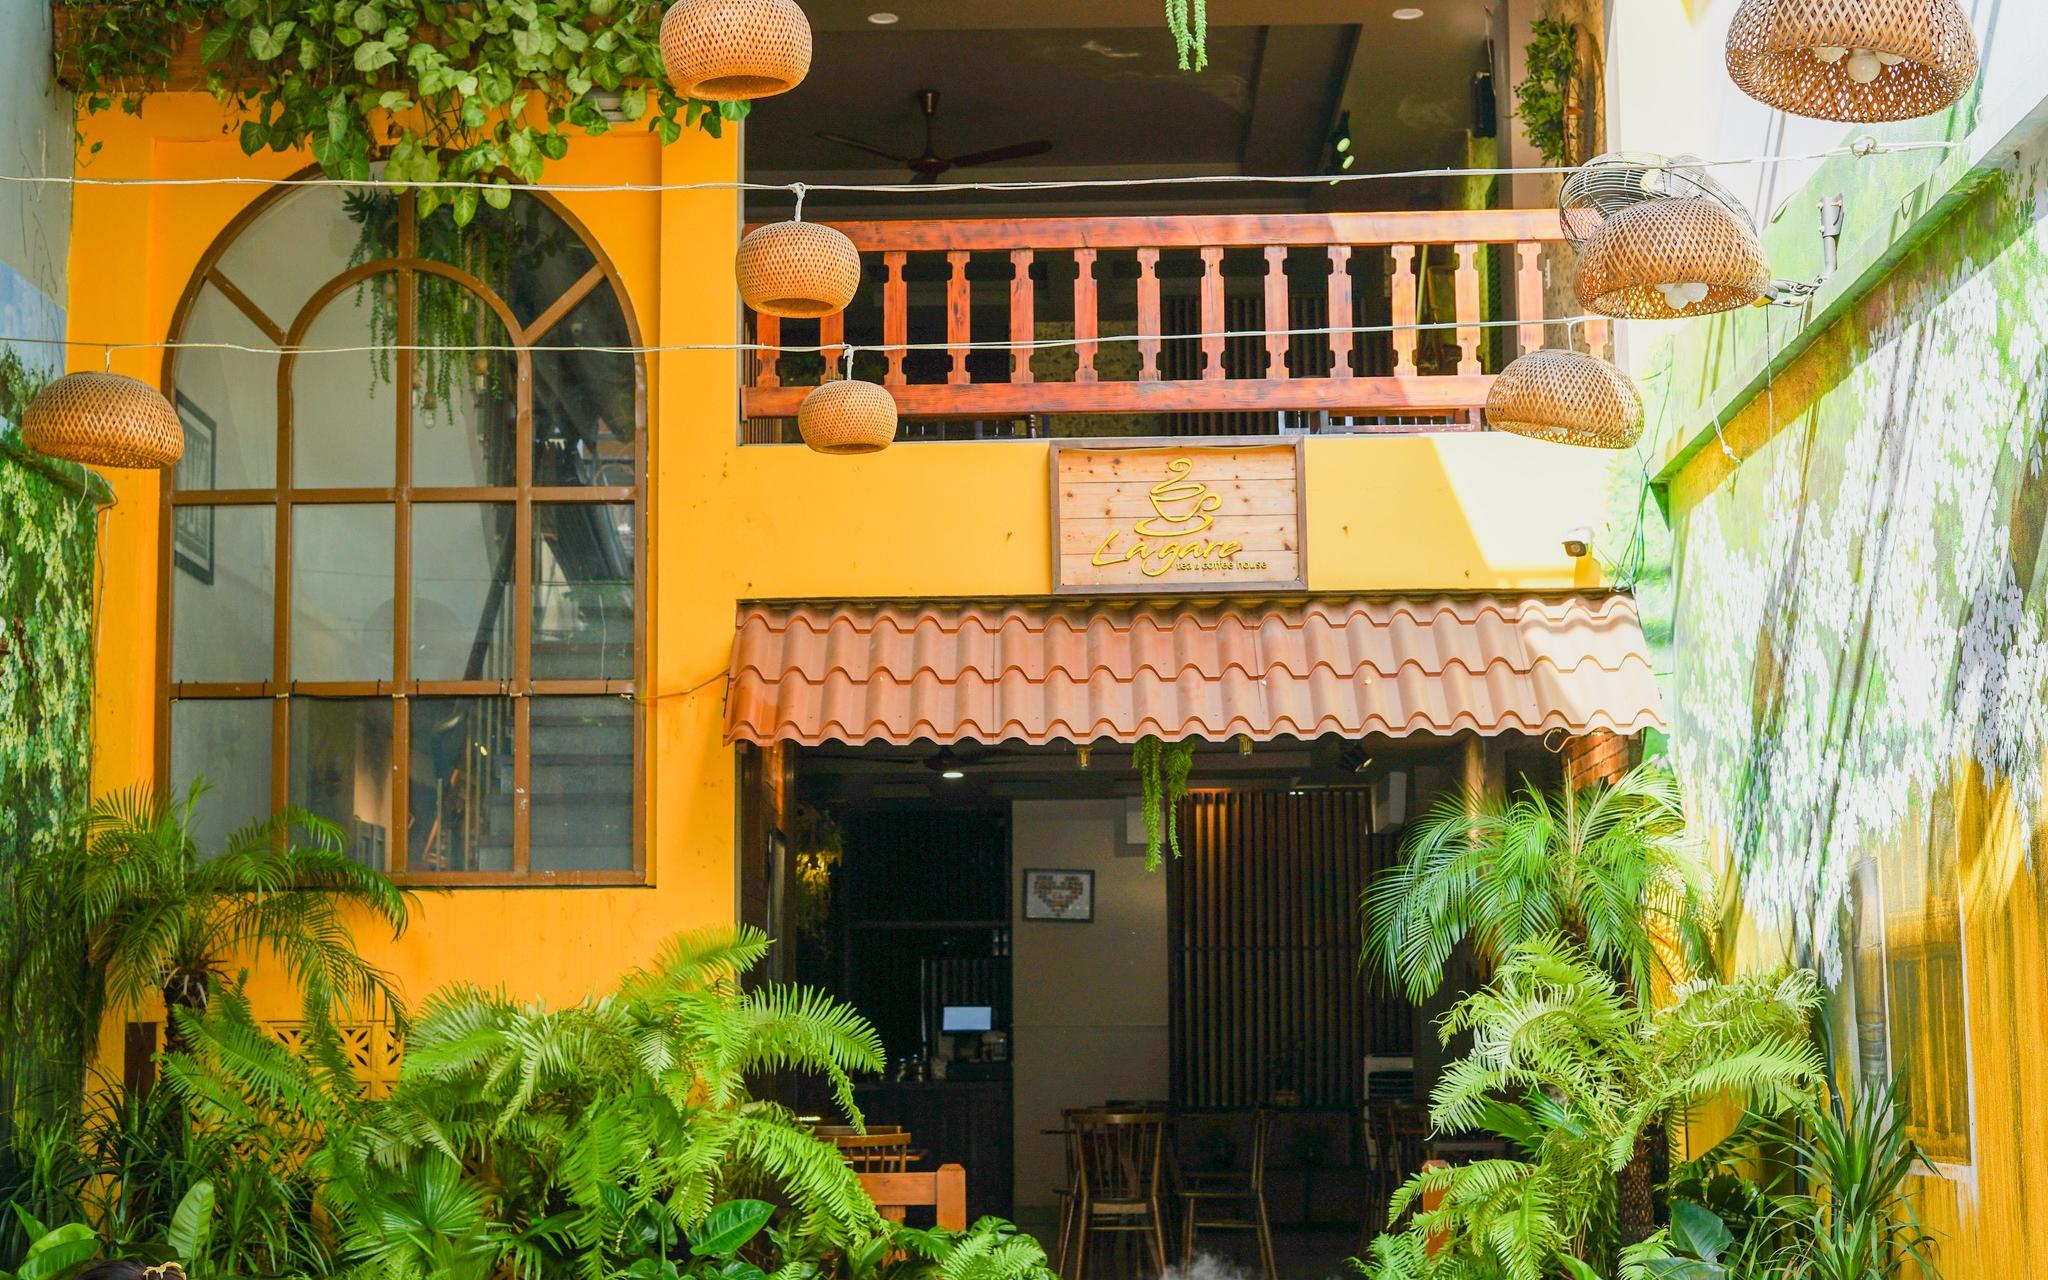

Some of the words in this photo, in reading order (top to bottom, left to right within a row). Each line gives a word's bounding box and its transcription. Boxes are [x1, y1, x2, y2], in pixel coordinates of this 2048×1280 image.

[1176, 562, 1192, 571] tea
[1201, 560, 1234, 571] coffee
[1236, 560, 1267, 570] house
